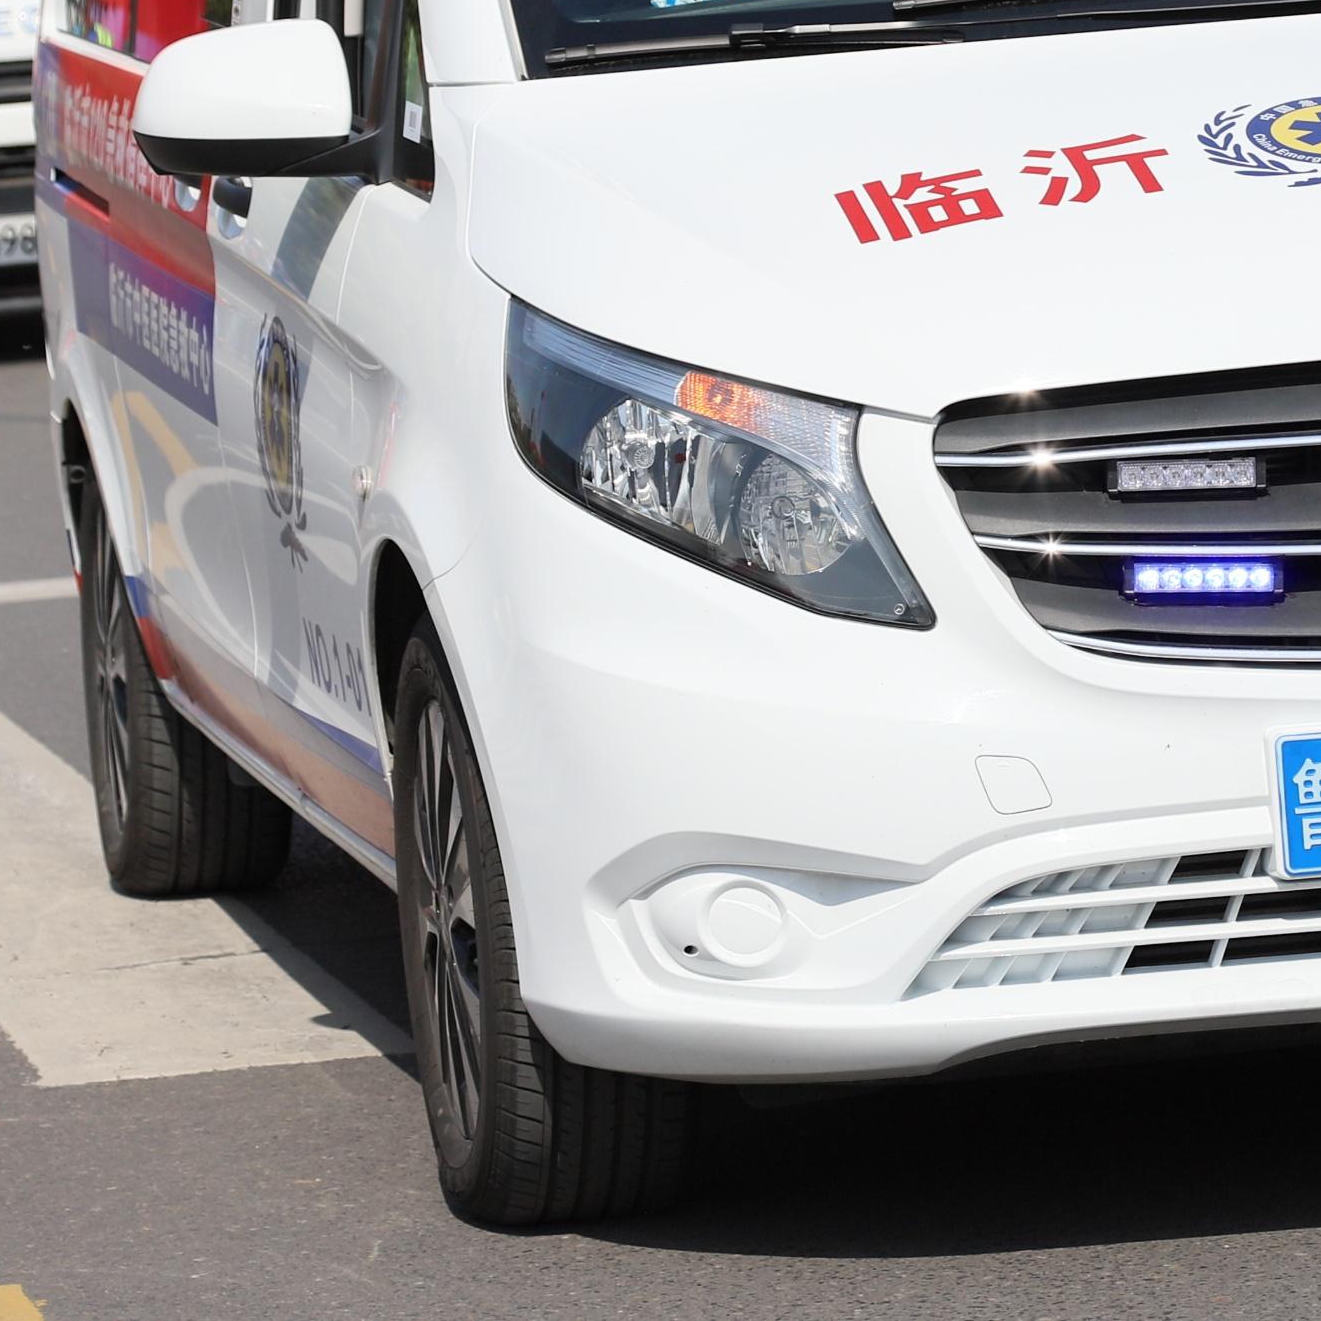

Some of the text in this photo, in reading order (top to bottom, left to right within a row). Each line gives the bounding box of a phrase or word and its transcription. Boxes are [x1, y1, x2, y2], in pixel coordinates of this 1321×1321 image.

[835, 134, 1168, 244] 临沂
[1252, 133, 1275, 153] China
[301, 616, 372, 718] NO.1-01
